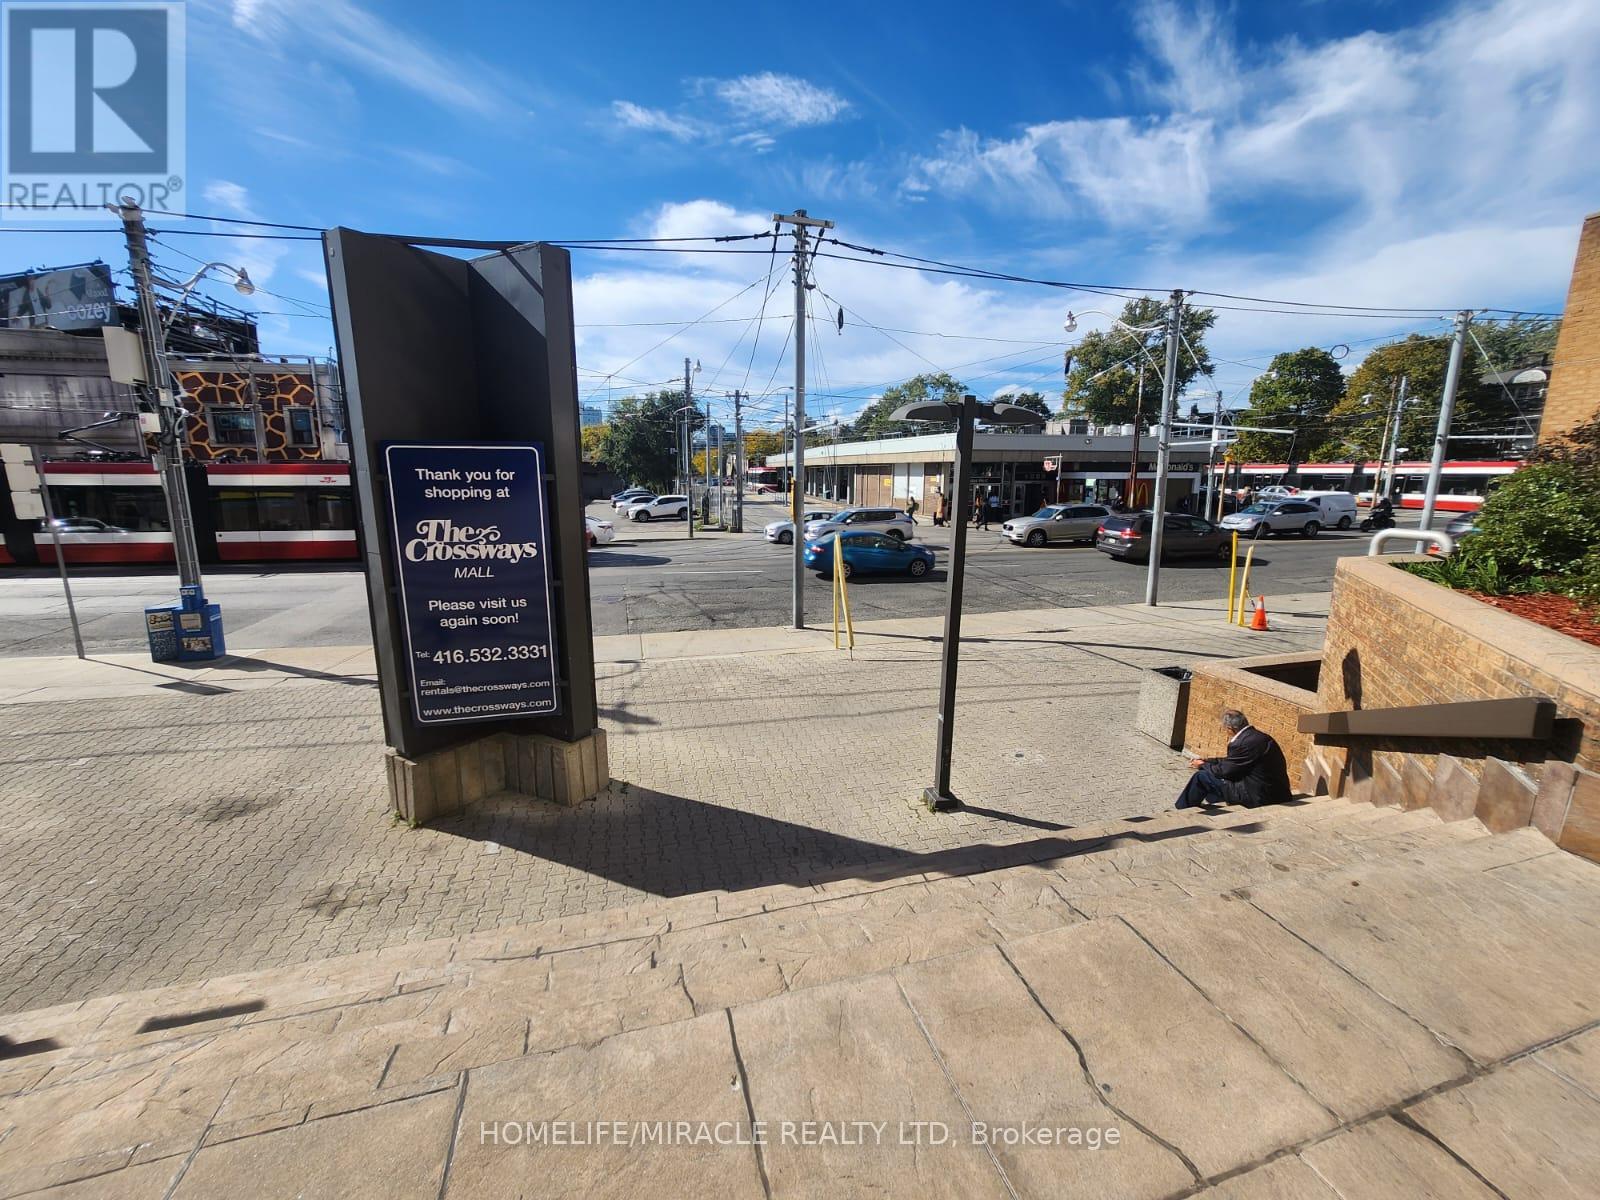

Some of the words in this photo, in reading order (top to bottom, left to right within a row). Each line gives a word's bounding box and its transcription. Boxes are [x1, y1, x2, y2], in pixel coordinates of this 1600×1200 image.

[1148, 463, 1194, 472] Monald's
[415, 468, 461, 481] Thank
[465, 470, 491, 483] you
[495, 469, 515, 481] for
[424, 486, 492, 500] shopping
[496, 486, 510, 498] at
[416, 519, 500, 544] The
[405, 539, 537, 563] Crossways
[454, 567, 495, 578] MALL
[428, 600, 475, 611] Please
[479, 598, 507, 609] visit
[511, 598, 527, 608] us
[440, 615, 478, 629] again
[482, 613, 519, 625] soon!
[416, 651, 430, 659] Tel:
[433, 644, 548, 665] 416.532.3331
[420, 679, 446, 687] Email:
[420, 680, 550, 696] rentals@thecrossways.com
[422, 699, 551, 717] www.thecrossways.com
